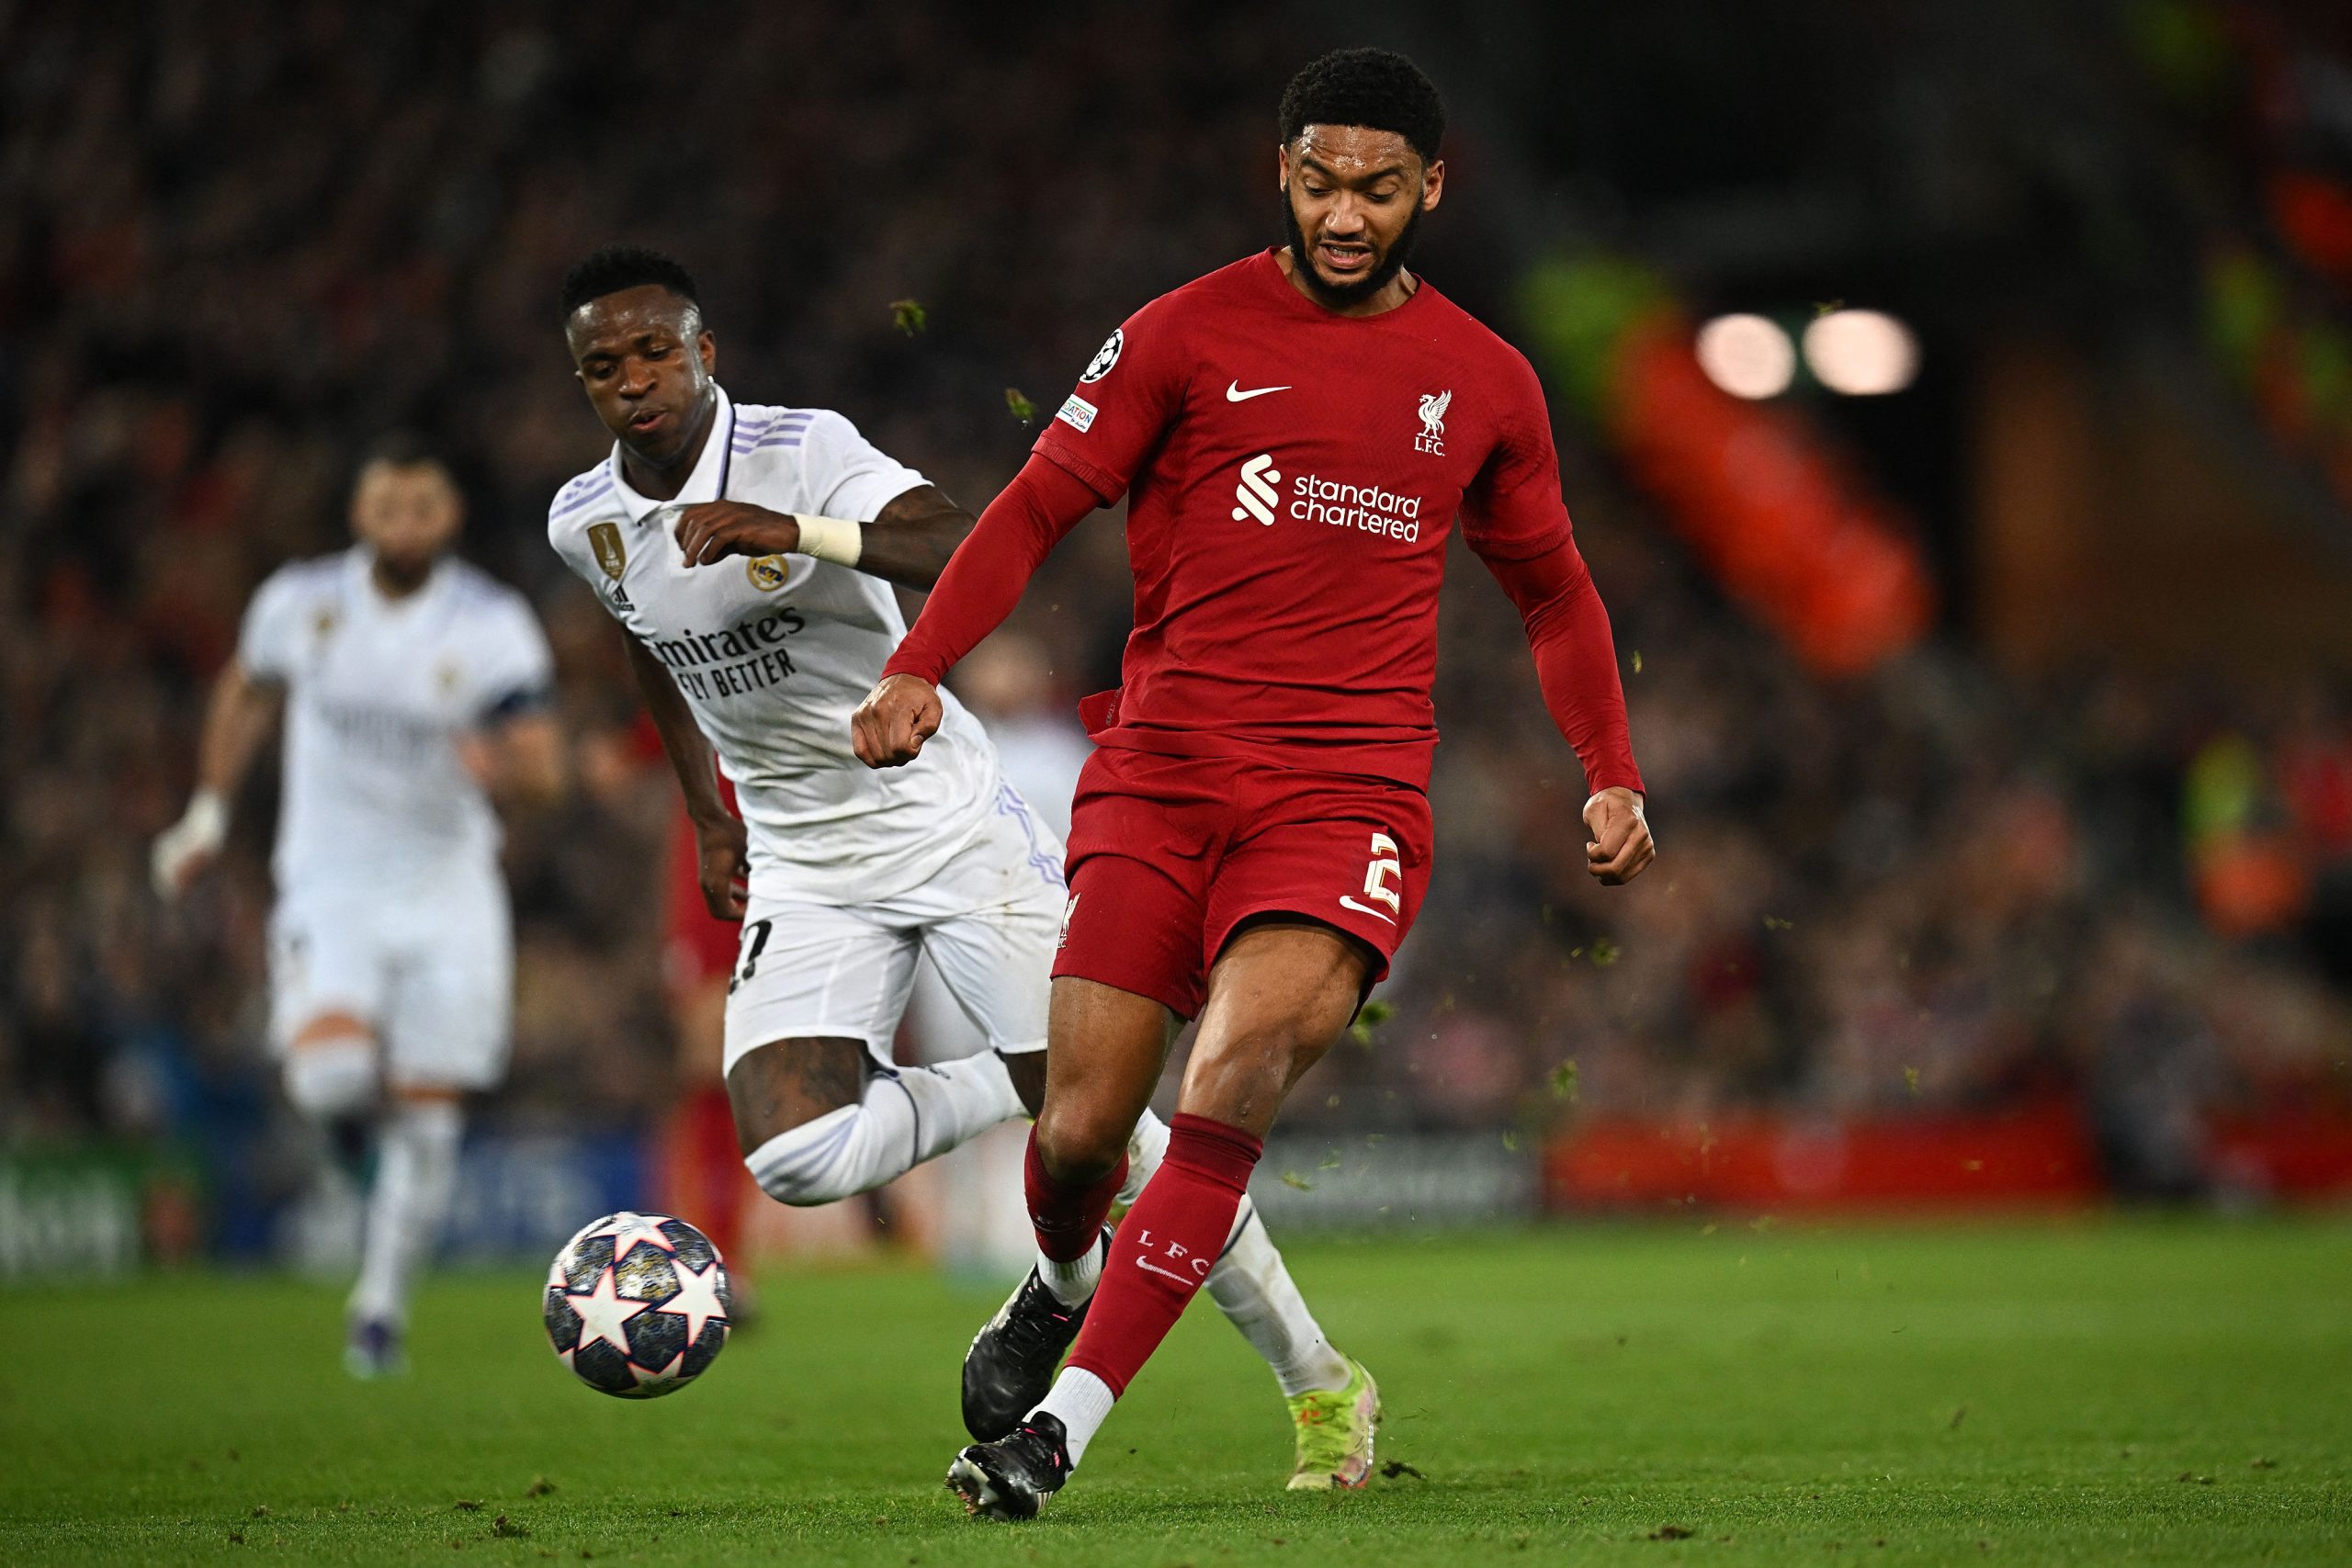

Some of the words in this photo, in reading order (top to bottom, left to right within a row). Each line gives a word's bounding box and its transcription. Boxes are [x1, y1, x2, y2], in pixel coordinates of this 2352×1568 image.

[1062, 401, 1092, 423] DATION
[1290, 498, 1419, 544] chartered
[1294, 474, 1421, 519] standard
[653, 606, 806, 668] mirates
[678, 672, 710, 700] FLY
[711, 648, 797, 698] BETTER
[1363, 832, 1402, 915] 2
